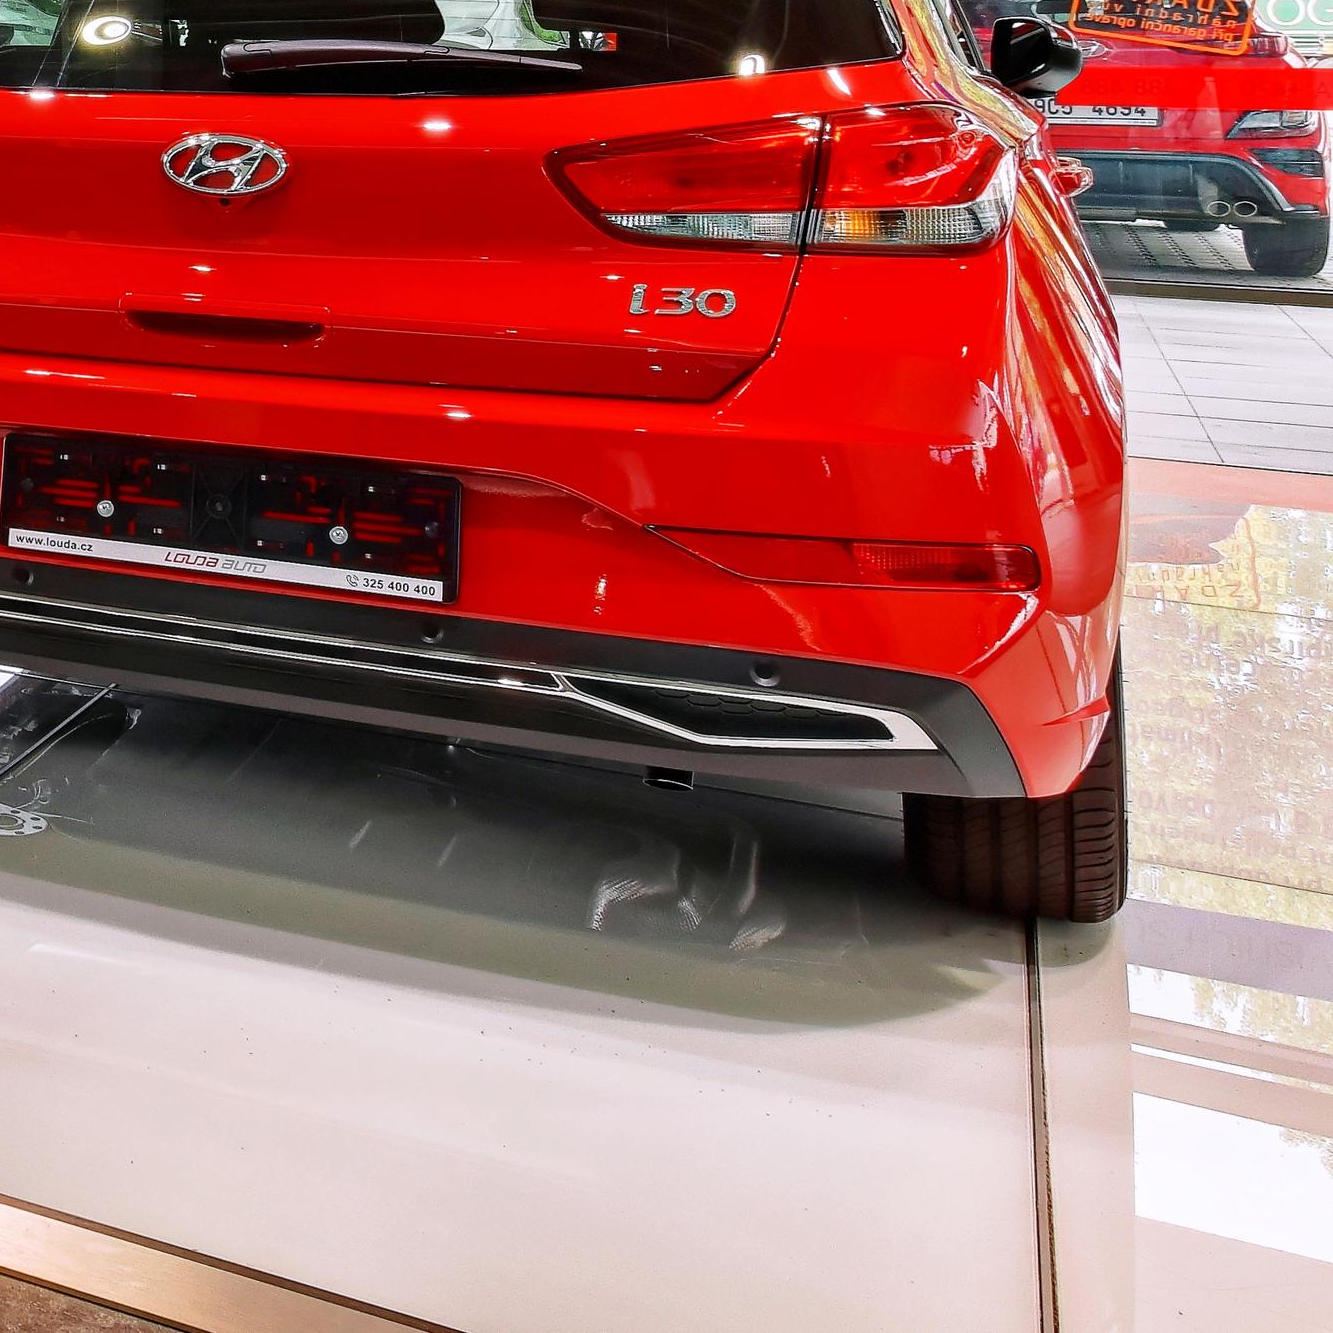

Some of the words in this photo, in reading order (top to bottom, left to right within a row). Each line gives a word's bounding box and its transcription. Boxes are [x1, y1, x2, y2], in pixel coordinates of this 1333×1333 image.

[627, 281, 738, 319] i30
[15, 533, 94, 554] www.louda.cz
[164, 551, 219, 568] LOUDA
[220, 556, 267, 574] AUTO
[362, 577, 385, 590] 325
[387, 580, 411, 593] 400
[413, 583, 436, 597] 400
